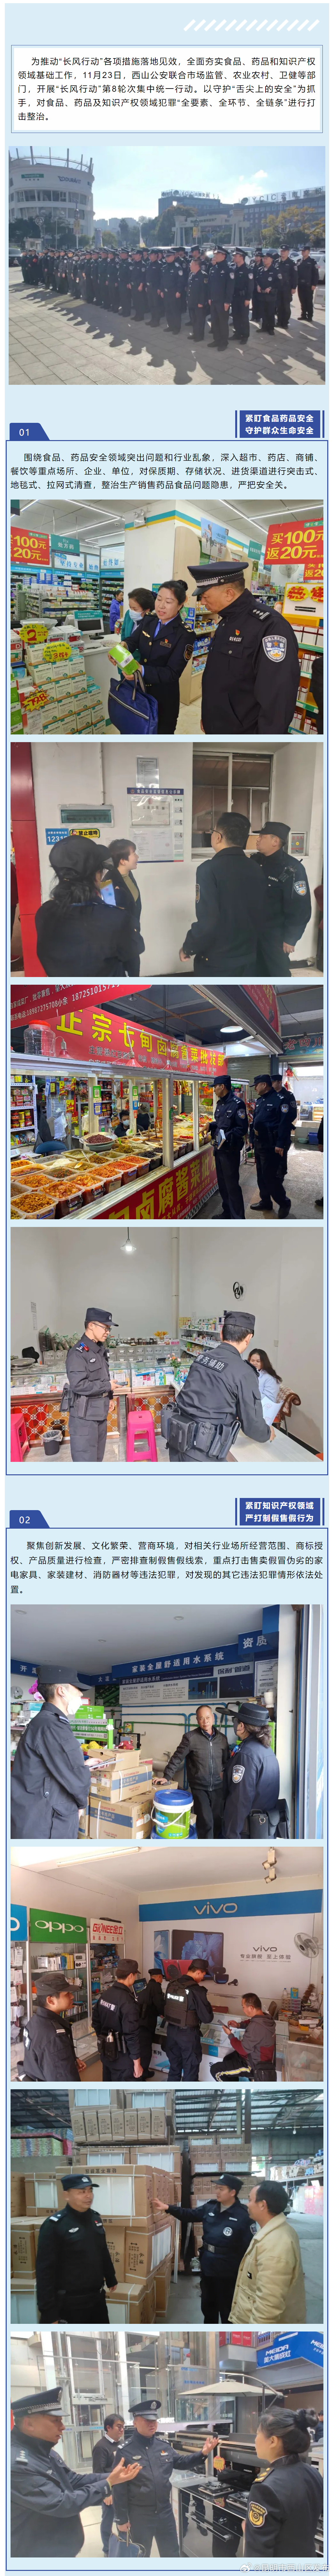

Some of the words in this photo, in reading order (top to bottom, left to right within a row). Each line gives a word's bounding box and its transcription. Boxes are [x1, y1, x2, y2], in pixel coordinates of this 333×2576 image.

[281, 188, 322, 199] 云南交投
[266, 545, 318, 560] 返20元
[60, 560, 84, 568] 坚持专业
[27, 629, 37, 641] 2
[27, 693, 46, 706] 79.8
[196, 1354, 225, 1370] 警务辅助
[243, 1635, 267, 1649] 资质
[132, 1651, 224, 1673] 家装全屋舒适用水系统
[122, 1676, 160, 1684] 家装全屋舒适用水系统
[193, 1901, 238, 1915] vivo
[100, 1999, 116, 2011] 特SWAT警
[265, 2344, 289, 2356] MEIDA
[264, 2350, 291, 2364] 美大集成灶
